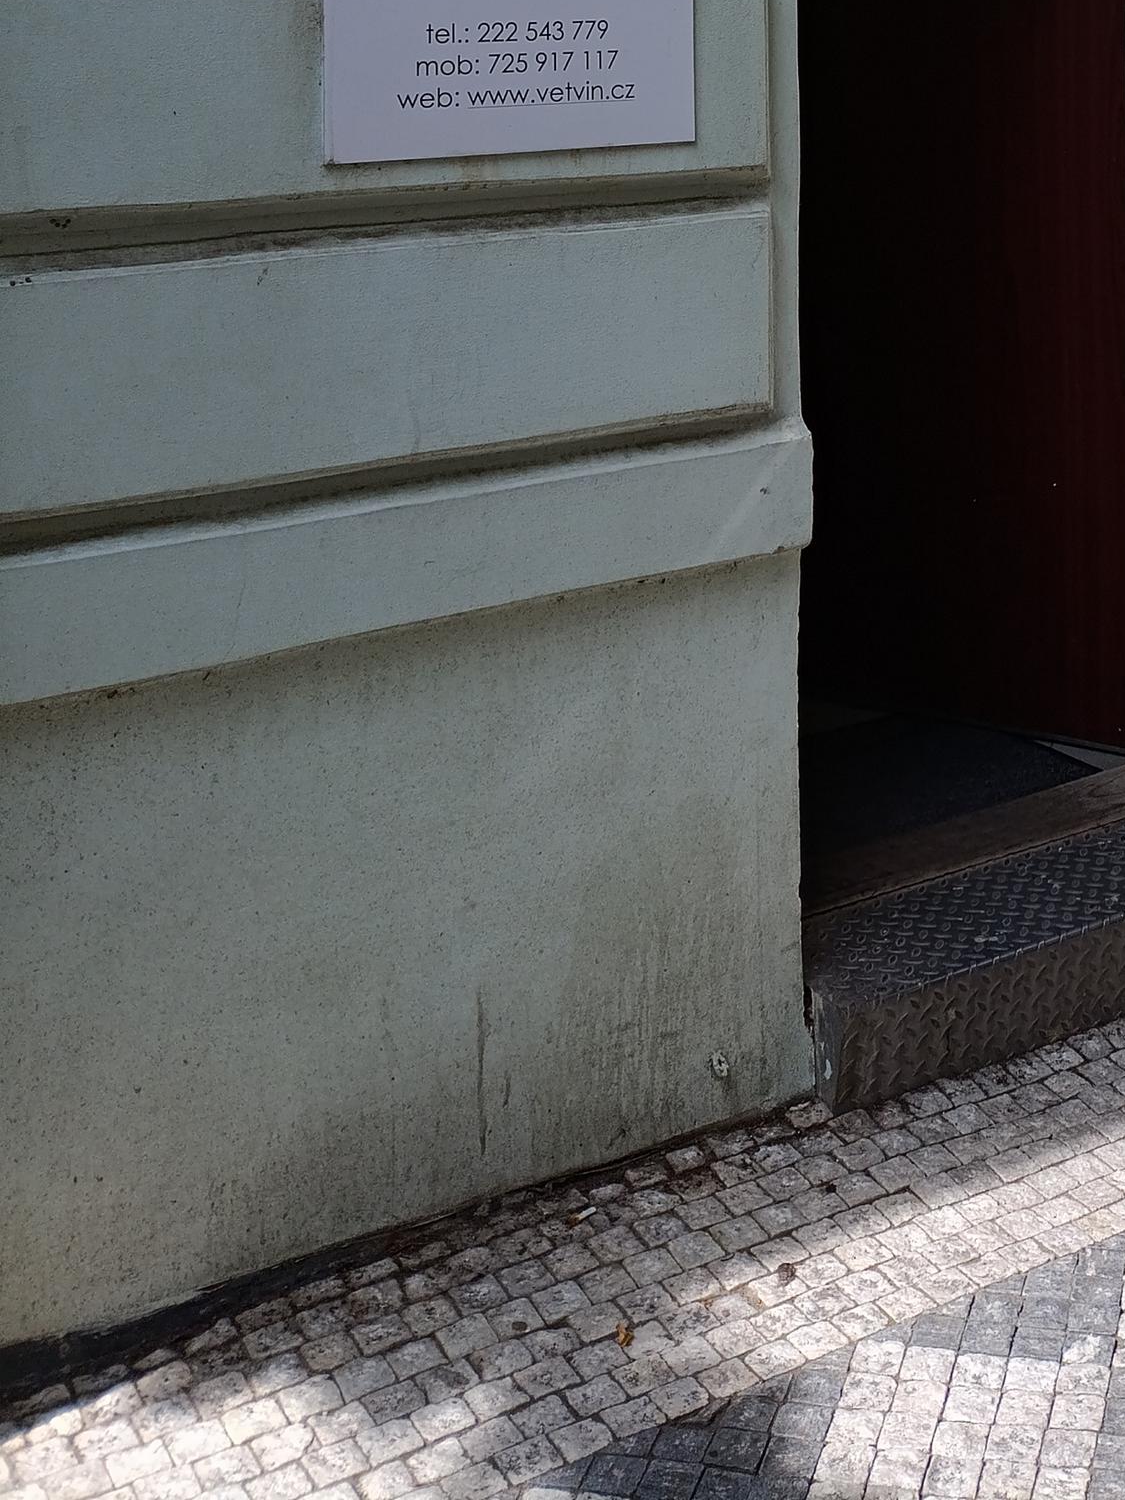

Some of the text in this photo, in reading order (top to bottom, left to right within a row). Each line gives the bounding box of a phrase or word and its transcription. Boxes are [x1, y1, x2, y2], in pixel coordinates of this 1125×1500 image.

[425, 19, 610, 44] tel.: 222 543 779
[416, 49, 619, 77] mob: 725 917 117
[396, 80, 636, 109] web: www.vetvin.cz
